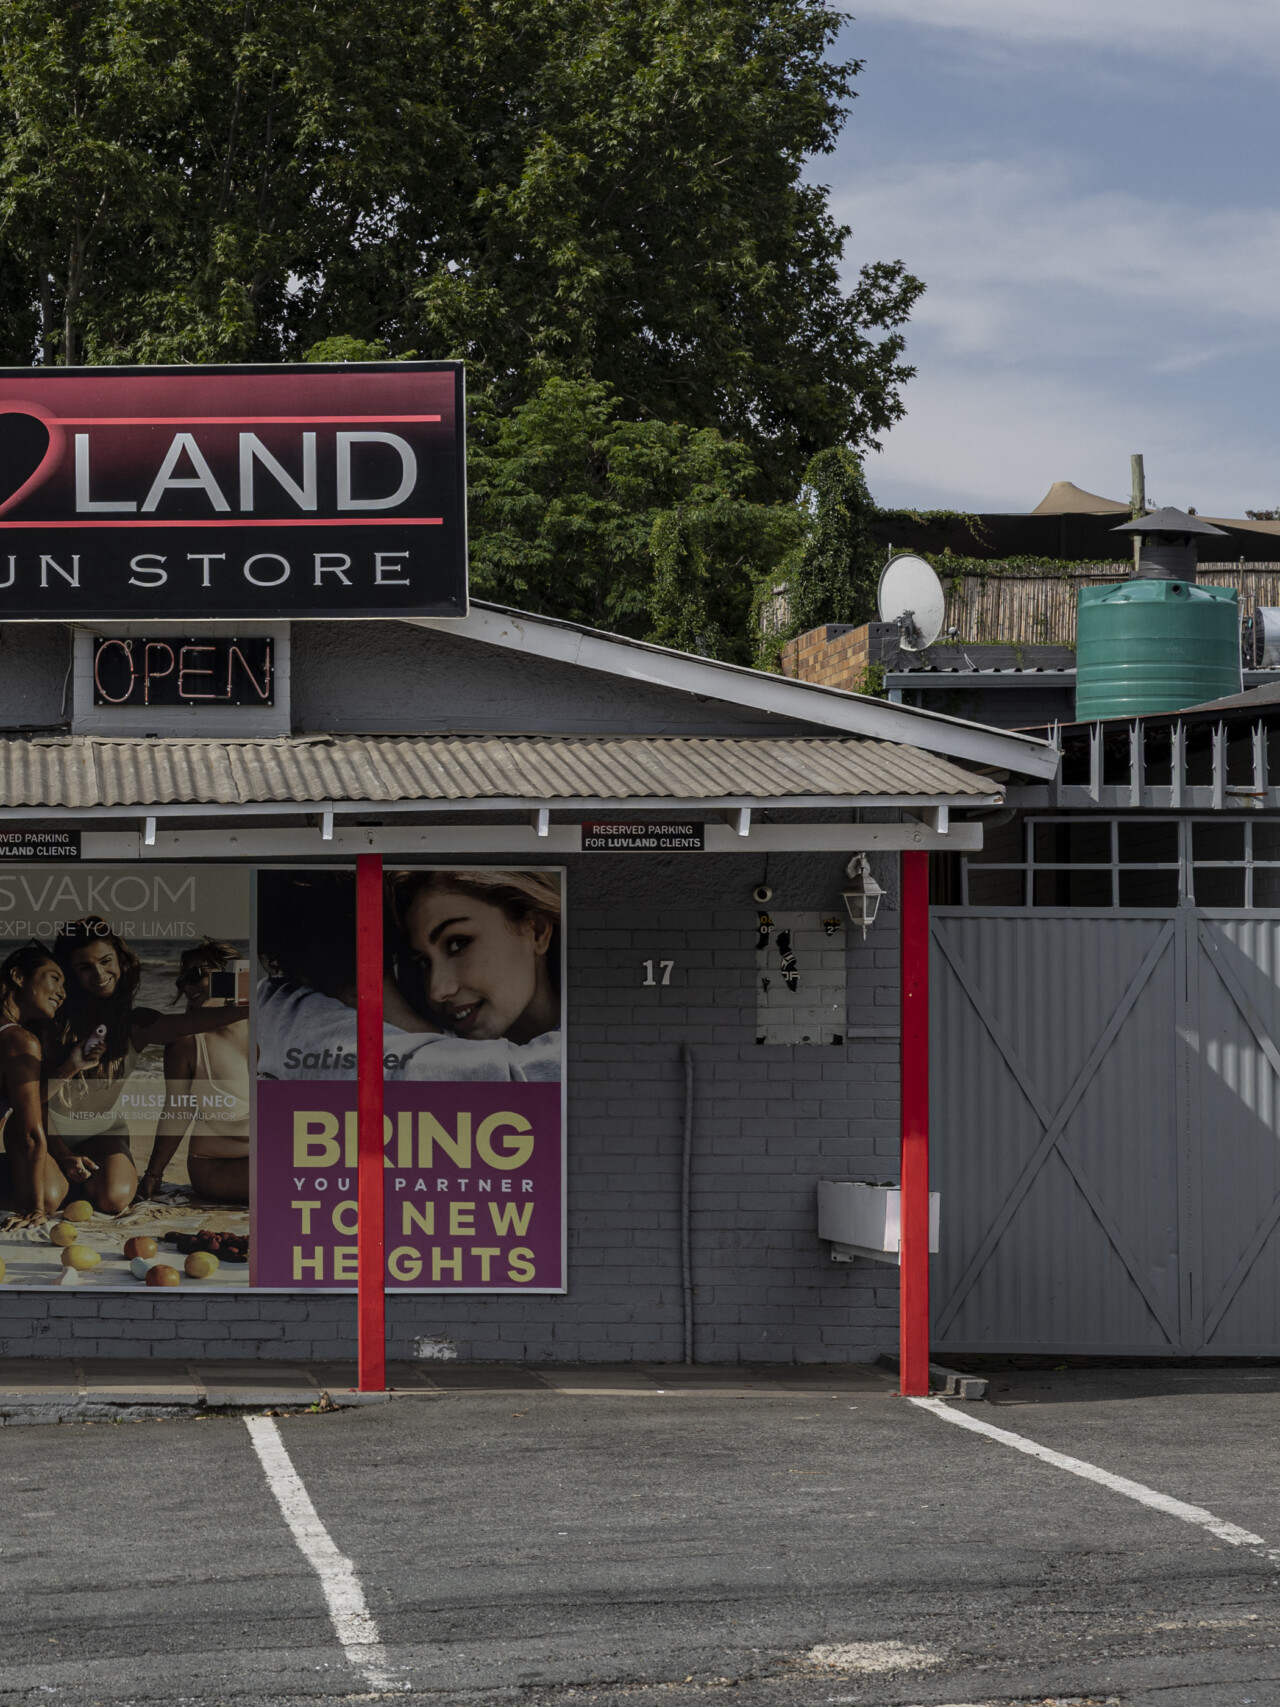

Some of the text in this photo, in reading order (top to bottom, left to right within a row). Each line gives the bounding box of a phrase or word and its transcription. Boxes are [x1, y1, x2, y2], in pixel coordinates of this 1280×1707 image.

[75, 431, 417, 512] LAND
[129, 551, 410, 587] STORE
[95, 640, 270, 702] OPEN
[25, 833, 69, 843] PARKING
[593, 825, 693, 834] RESERVED PARKING
[37, 846, 77, 855] CLIENTS
[585, 838, 701, 847] FOR LUVLAND CLIENTS
[84, 920, 135, 937] YOUR
[142, 921, 195, 937] LIMITS
[642, 960, 674, 986] 17
[283, 1046, 413, 1070] Satiser
[121, 1095, 237, 1108] PULSE LITE NEO
[70, 1112, 236, 1120] INTERACTIVE SUCTION STIMULATOR
[293, 1111, 535, 1170] BRING
[293, 1177, 534, 1193] YOU PARTNER
[291, 1200, 535, 1236] TO NEW
[293, 1246, 536, 1283] HEGHTS
